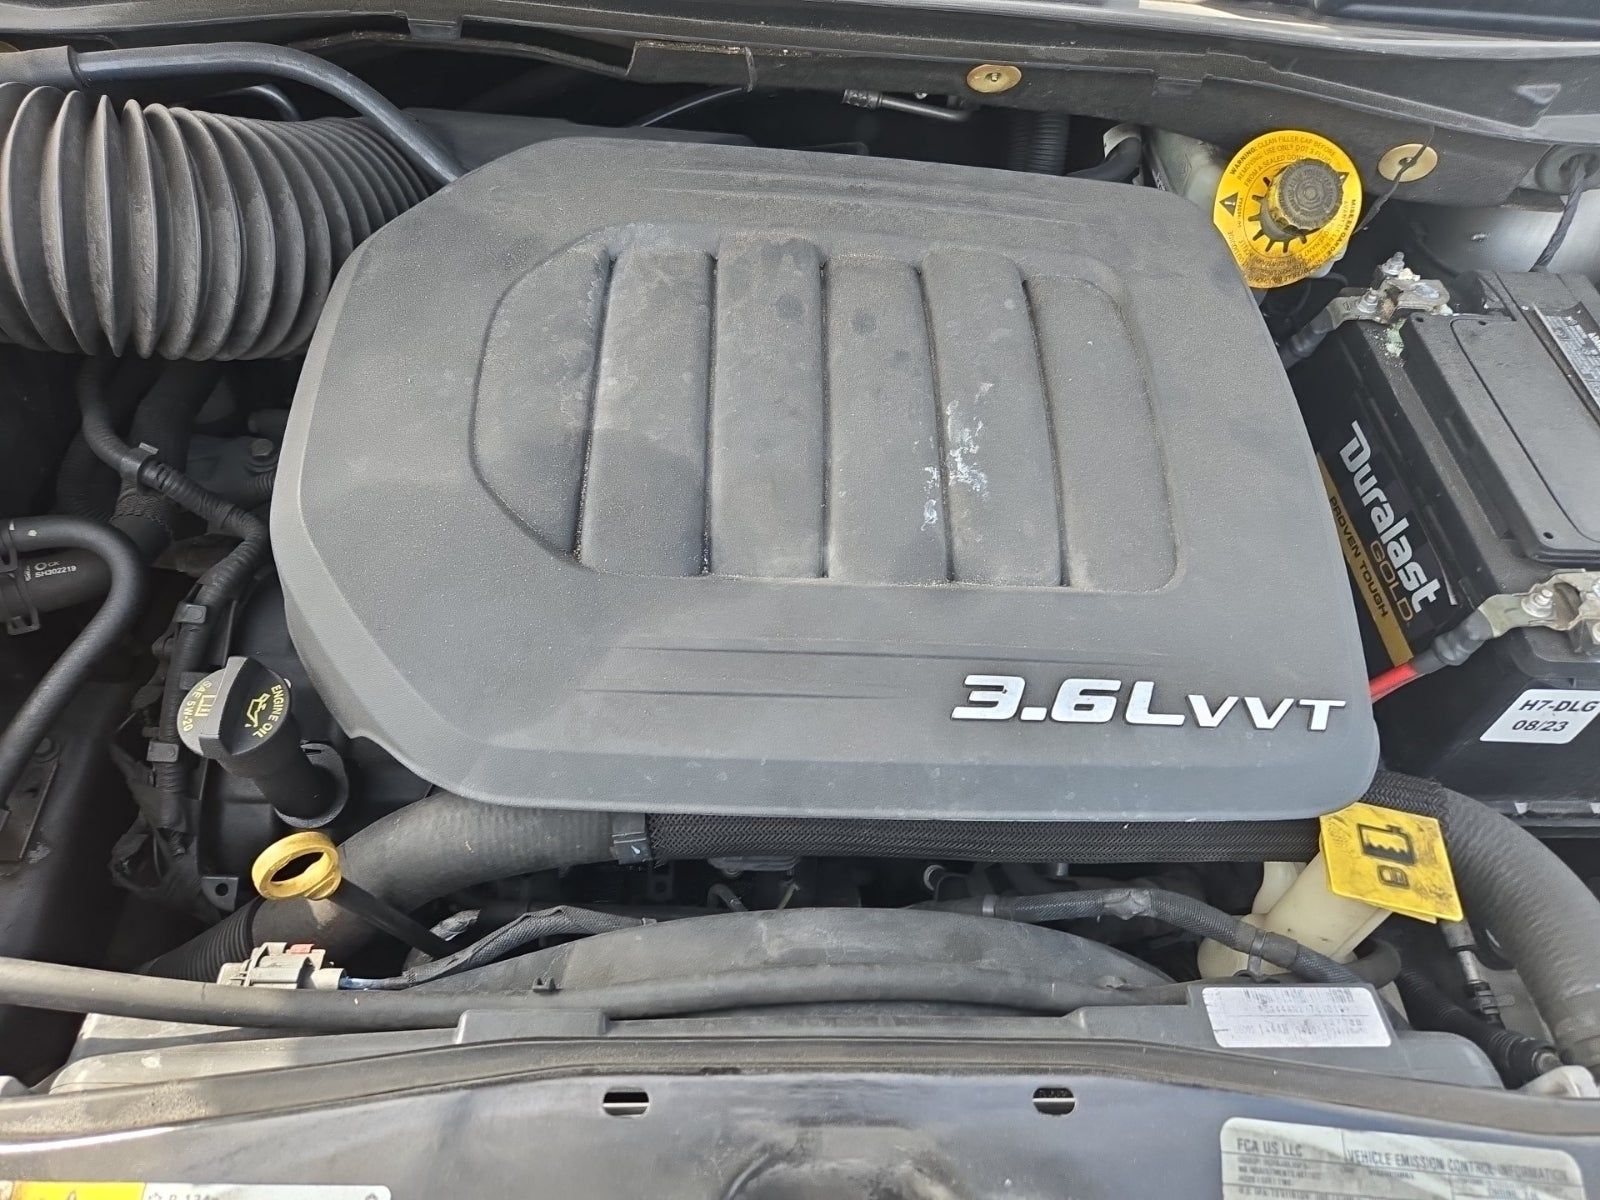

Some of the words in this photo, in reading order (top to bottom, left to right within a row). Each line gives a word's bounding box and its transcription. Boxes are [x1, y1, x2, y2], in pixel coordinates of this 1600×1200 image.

[1229, 146, 1257, 175] WARNING:
[1257, 136, 1278, 149] CLEAN
[1278, 135, 1299, 143] FILLER
[1348, 199, 1356, 219] MISE
[1339, 420, 1441, 614] Duralast
[1329, 496, 1361, 559] PROVEN
[1359, 559, 1389, 618] TOUGH
[1370, 540, 1414, 621] GOLD
[192, 680, 212, 699] SAE
[270, 684, 284, 722] ENGINE
[1518, 699, 1600, 712] H7-DLG
[252, 722, 274, 738] OIL
[1512, 720, 1569, 732] 08/23
[1237, 1138, 1259, 1153] FCA
[1263, 1140, 1279, 1155] US
[1282, 1142, 1303, 1157] LLC
[1346, 1149, 1392, 1166] VEHICLE
[1395, 1153, 1445, 1170] EMISSION
[1448, 1158, 1495, 1176] CONTROL
[1499, 1164, 1569, 1181] INFORMATION
